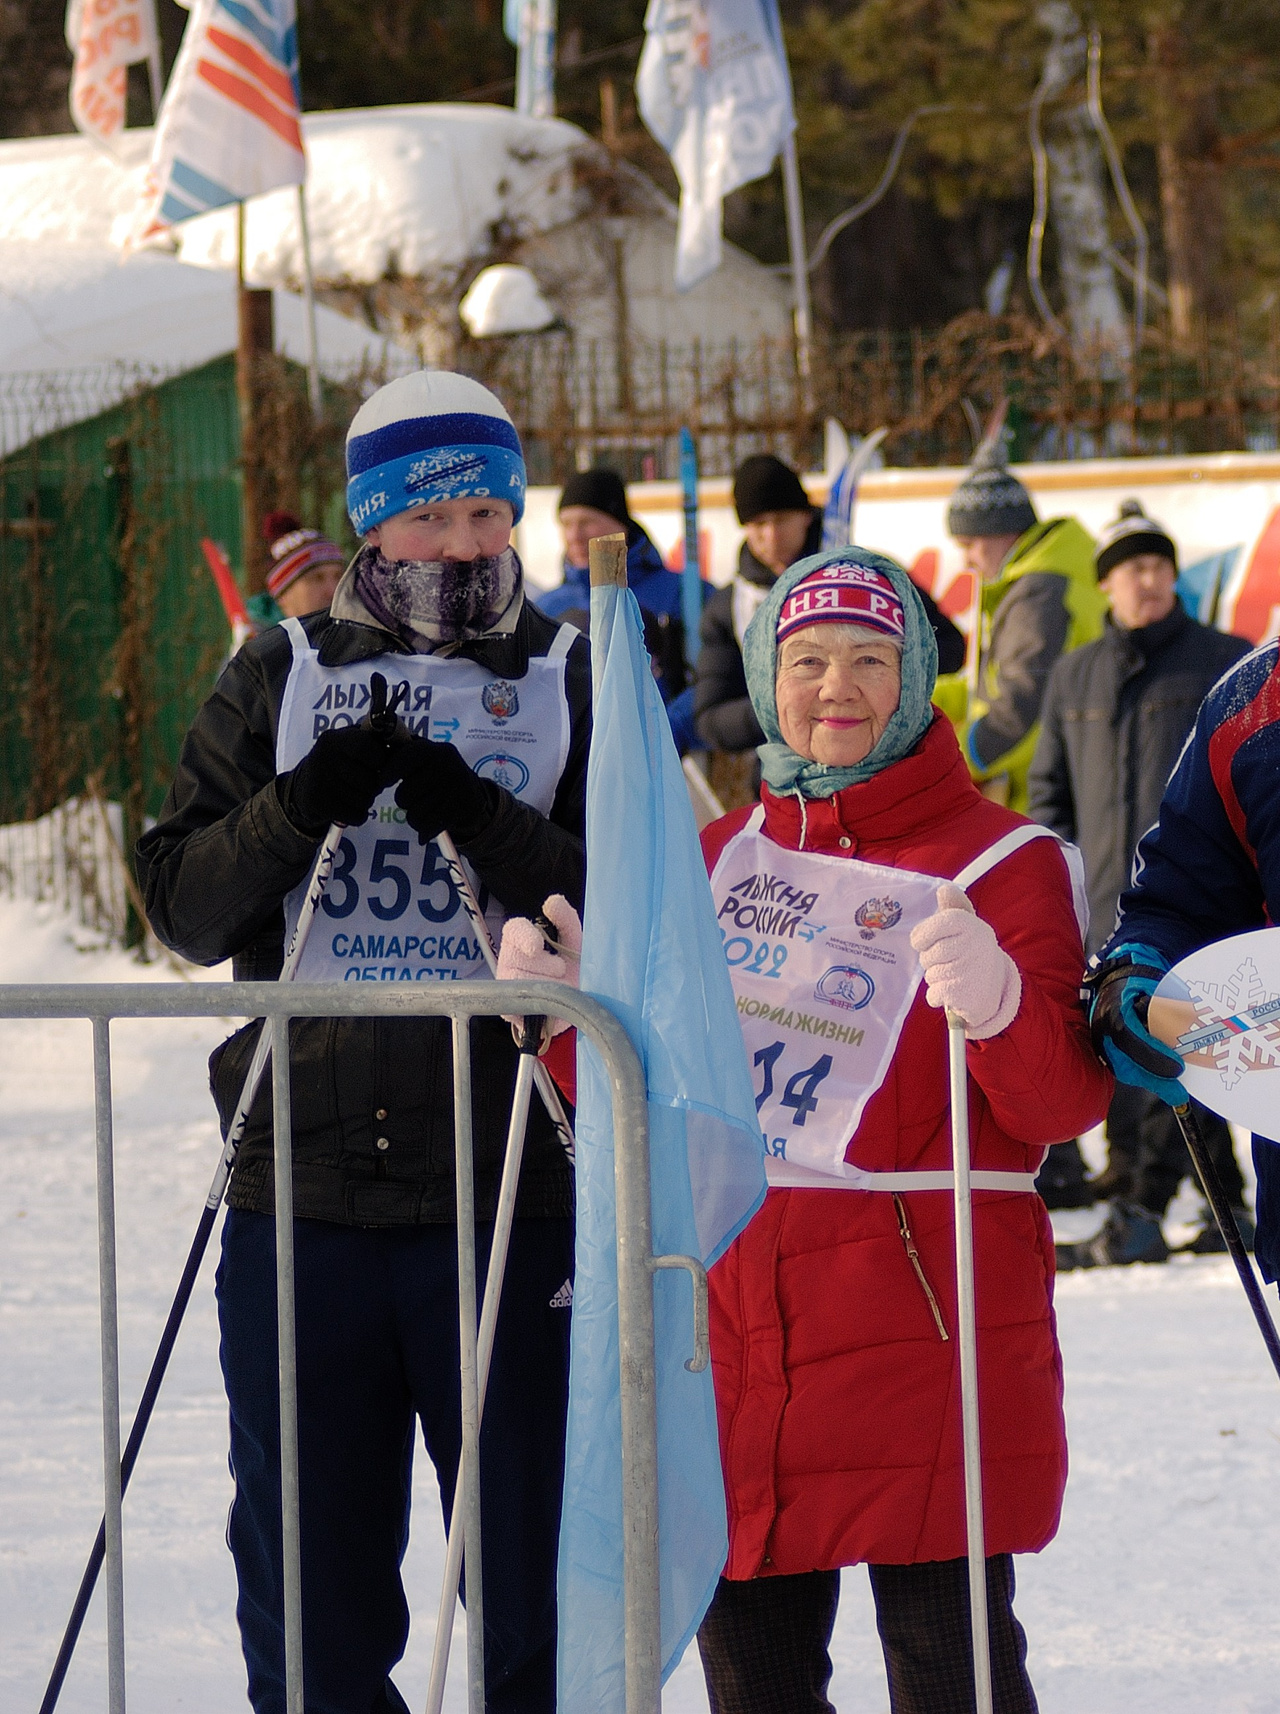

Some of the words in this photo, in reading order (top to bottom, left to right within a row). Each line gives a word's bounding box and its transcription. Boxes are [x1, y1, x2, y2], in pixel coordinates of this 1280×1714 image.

[320, 836, 490, 924] 355
[332, 933, 485, 961] САМАРСКАЯ
[720, 928, 789, 979] 022
[736, 996, 792, 1029] НОРМА
[795, 1012, 866, 1047] ЖИЗНИ
[1193, 1032, 1226, 1050] ЛЫЖНЯ
